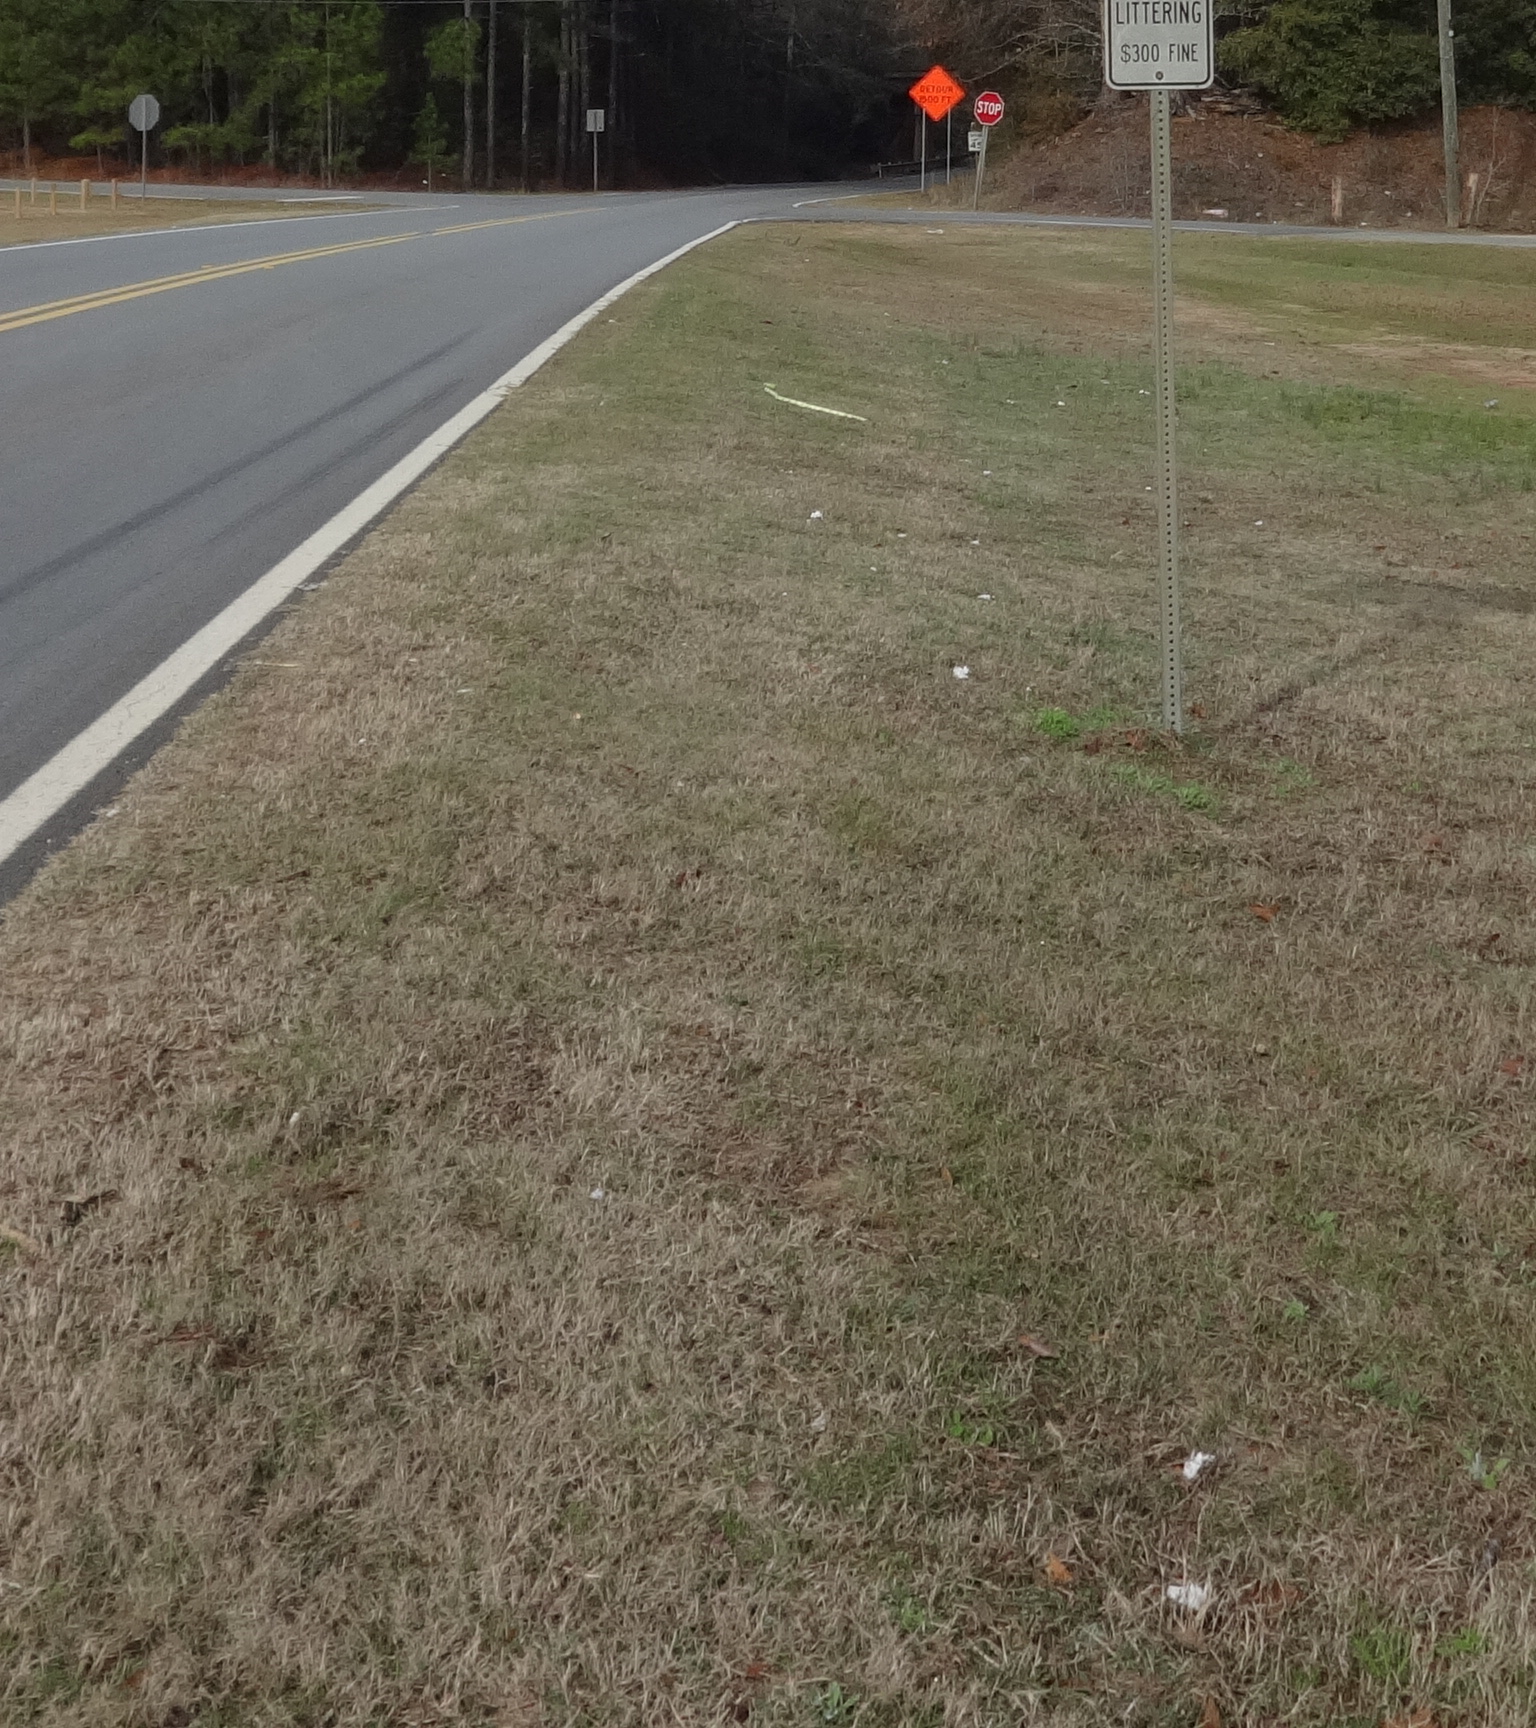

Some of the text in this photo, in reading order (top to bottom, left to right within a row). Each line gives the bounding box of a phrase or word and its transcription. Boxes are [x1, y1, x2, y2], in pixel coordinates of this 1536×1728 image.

[1116, 1, 1202, 24] LITTERING
[1120, 43, 1199, 63] $300 FINE
[920, 85, 953, 93] DETOUR
[941, 96, 951, 104] FT
[976, 101, 1002, 115] STOP
